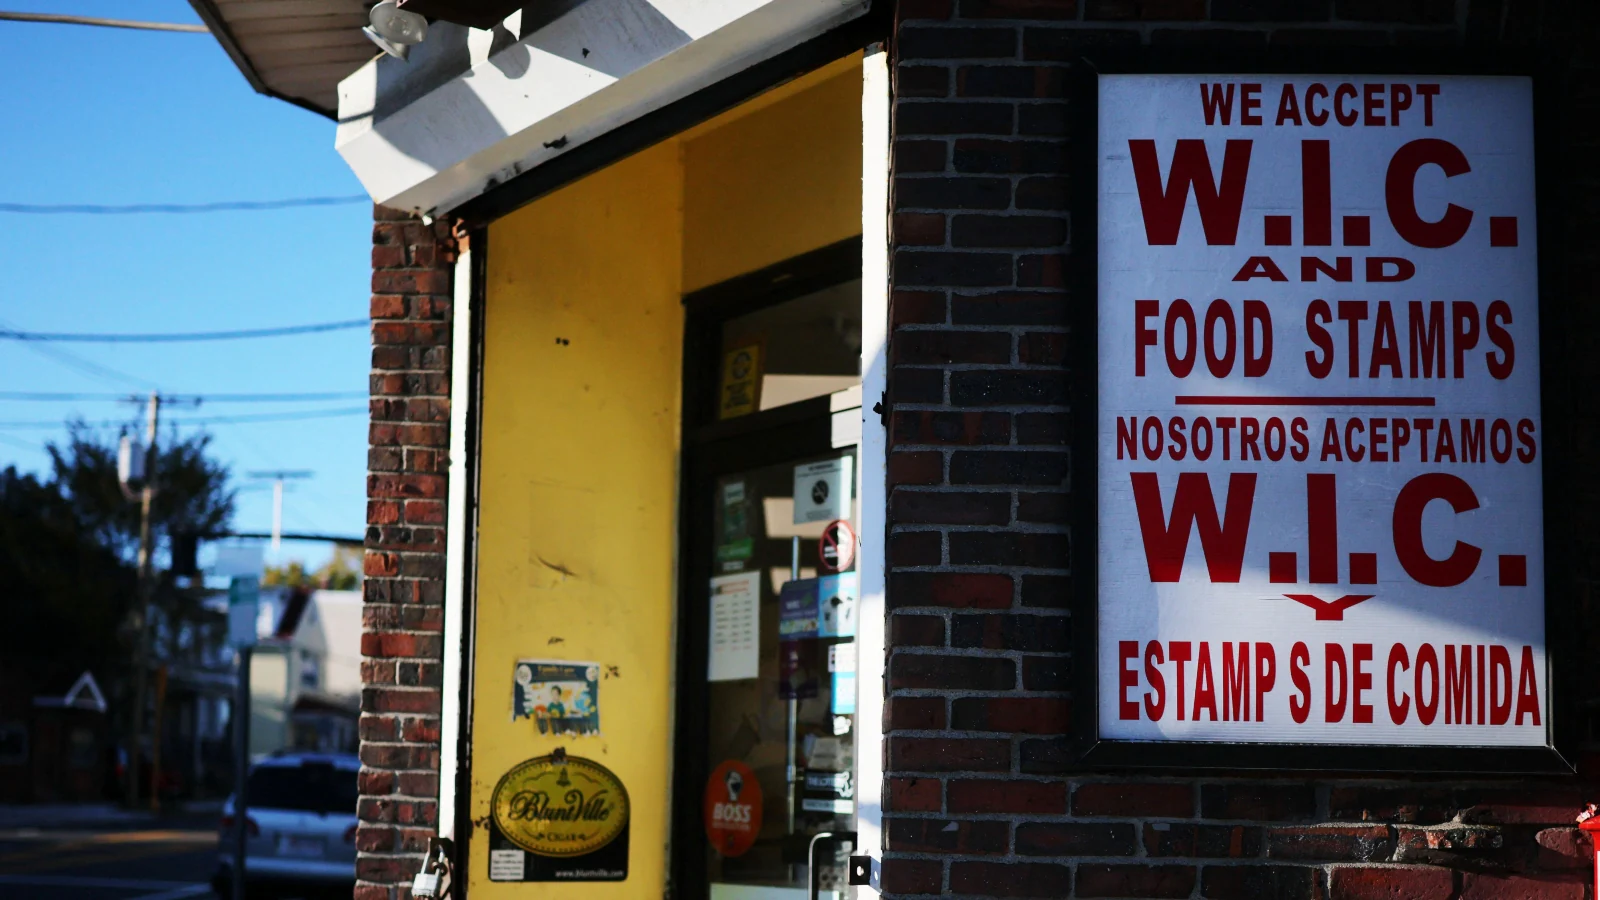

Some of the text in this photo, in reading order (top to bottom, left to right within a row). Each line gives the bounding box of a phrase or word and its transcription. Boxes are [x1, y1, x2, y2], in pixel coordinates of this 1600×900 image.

[1200, 82, 1441, 127] WE ACCEPT
[1127, 137, 1518, 249] W.I.C.
[1231, 255, 1416, 283] AND
[1134, 298, 1516, 381] FOOD STAMPS
[1116, 415, 1538, 465] NOSOTROS ACEPTAMOS
[1129, 471, 1528, 588] W.I.C.
[1324, 642, 1374, 724] DE
[1386, 642, 1542, 727] COMIDA
[713, 802, 752, 823] BOSS
